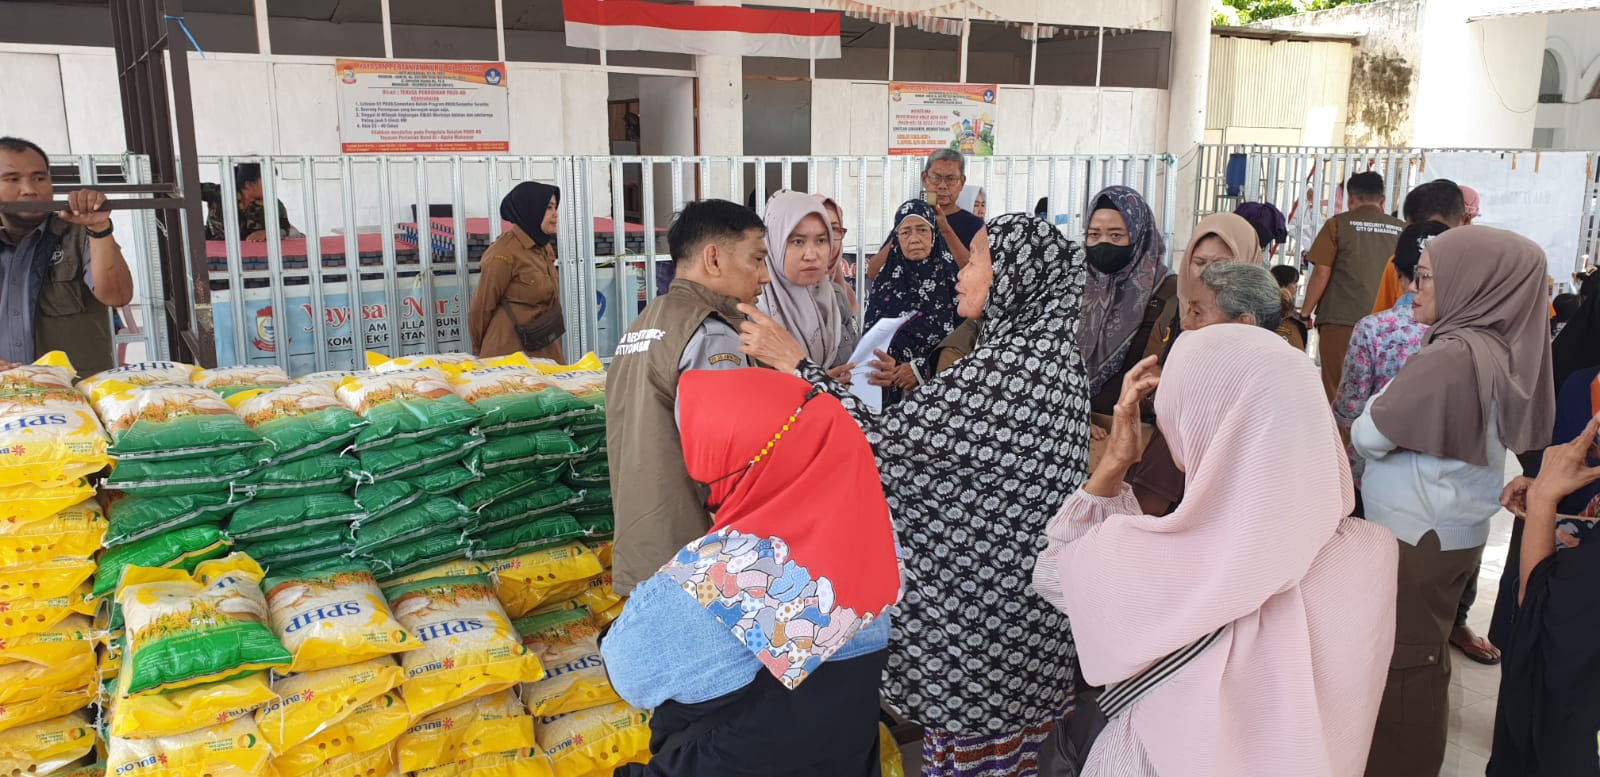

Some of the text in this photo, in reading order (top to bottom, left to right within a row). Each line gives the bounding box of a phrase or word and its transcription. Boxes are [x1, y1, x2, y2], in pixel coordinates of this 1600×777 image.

[284, 602, 361, 633] SPHP
[408, 661, 442, 678] BULOG
[115, 756, 157, 776] BULOG
